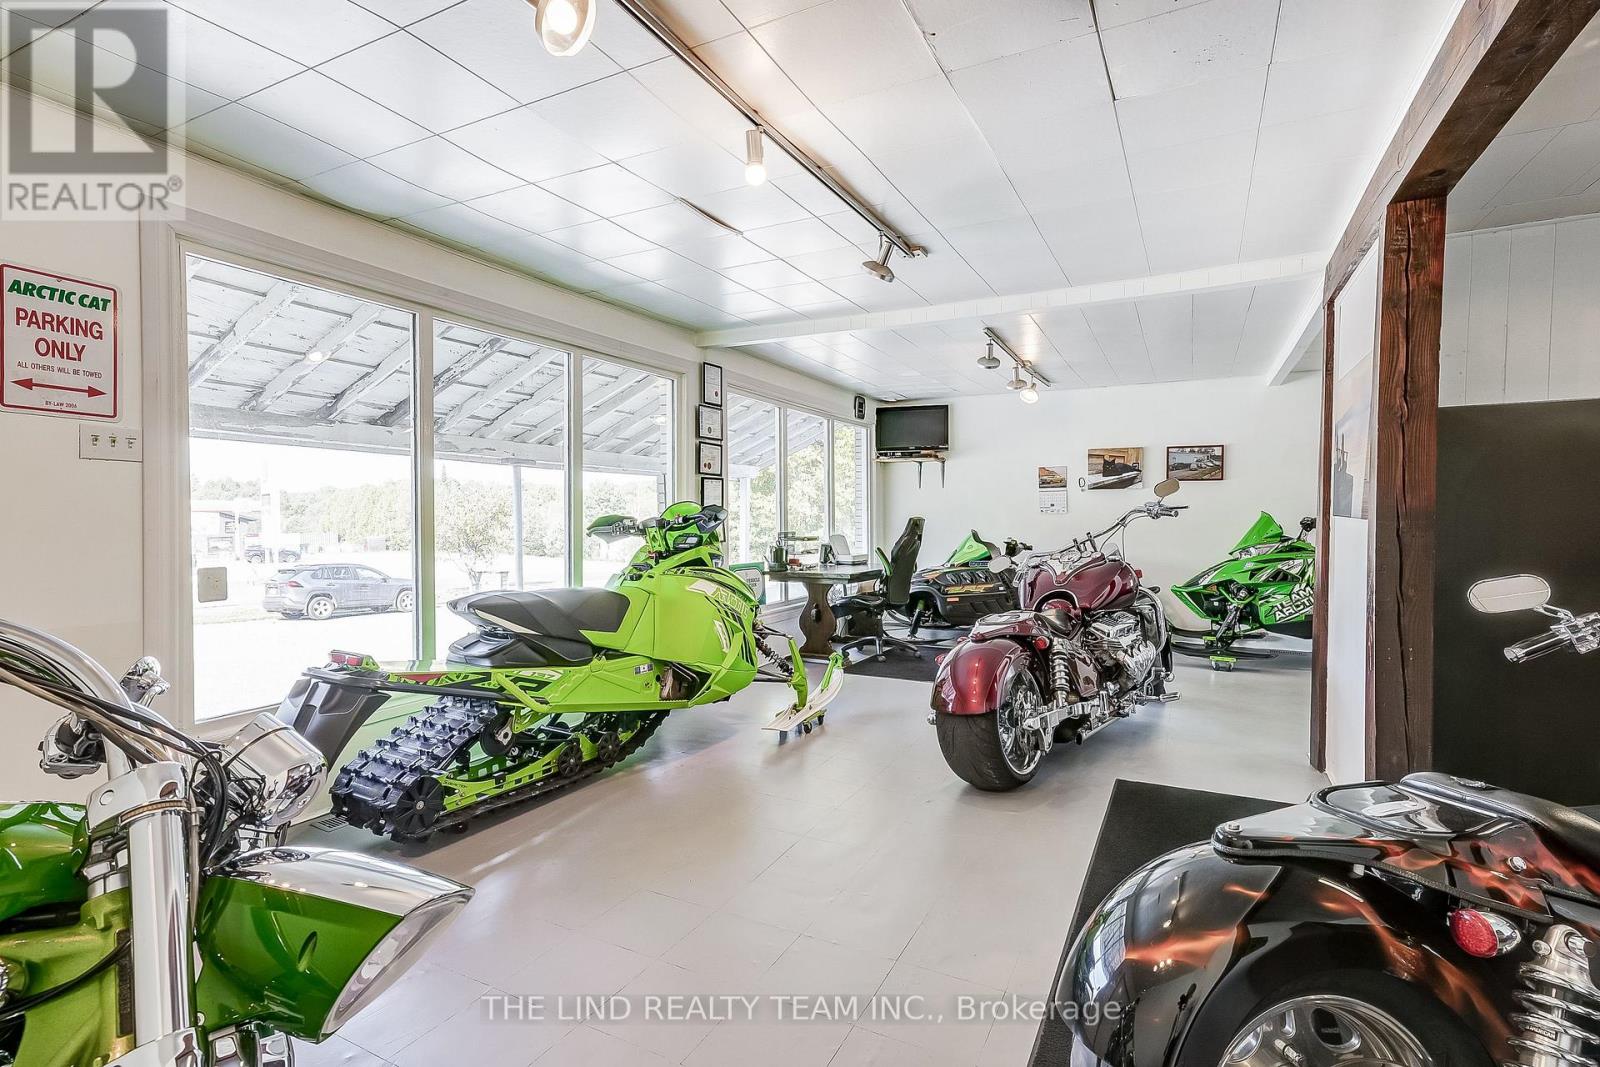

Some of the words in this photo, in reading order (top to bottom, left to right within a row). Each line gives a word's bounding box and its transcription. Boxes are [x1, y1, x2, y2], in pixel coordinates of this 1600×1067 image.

[7, 279, 76, 305] ARCTIC
[78, 293, 111, 312] CAT
[15, 306, 103, 340] PARKING
[34, 337, 86, 362] ONLY
[17, 360, 28, 369] ALL
[30, 362, 55, 373] OTHERS
[56, 366, 71, 375] WILL
[72, 368, 80, 376] BE
[82, 370, 102, 379] TOWED
[1275, 596, 1315, 621] ARCTI
